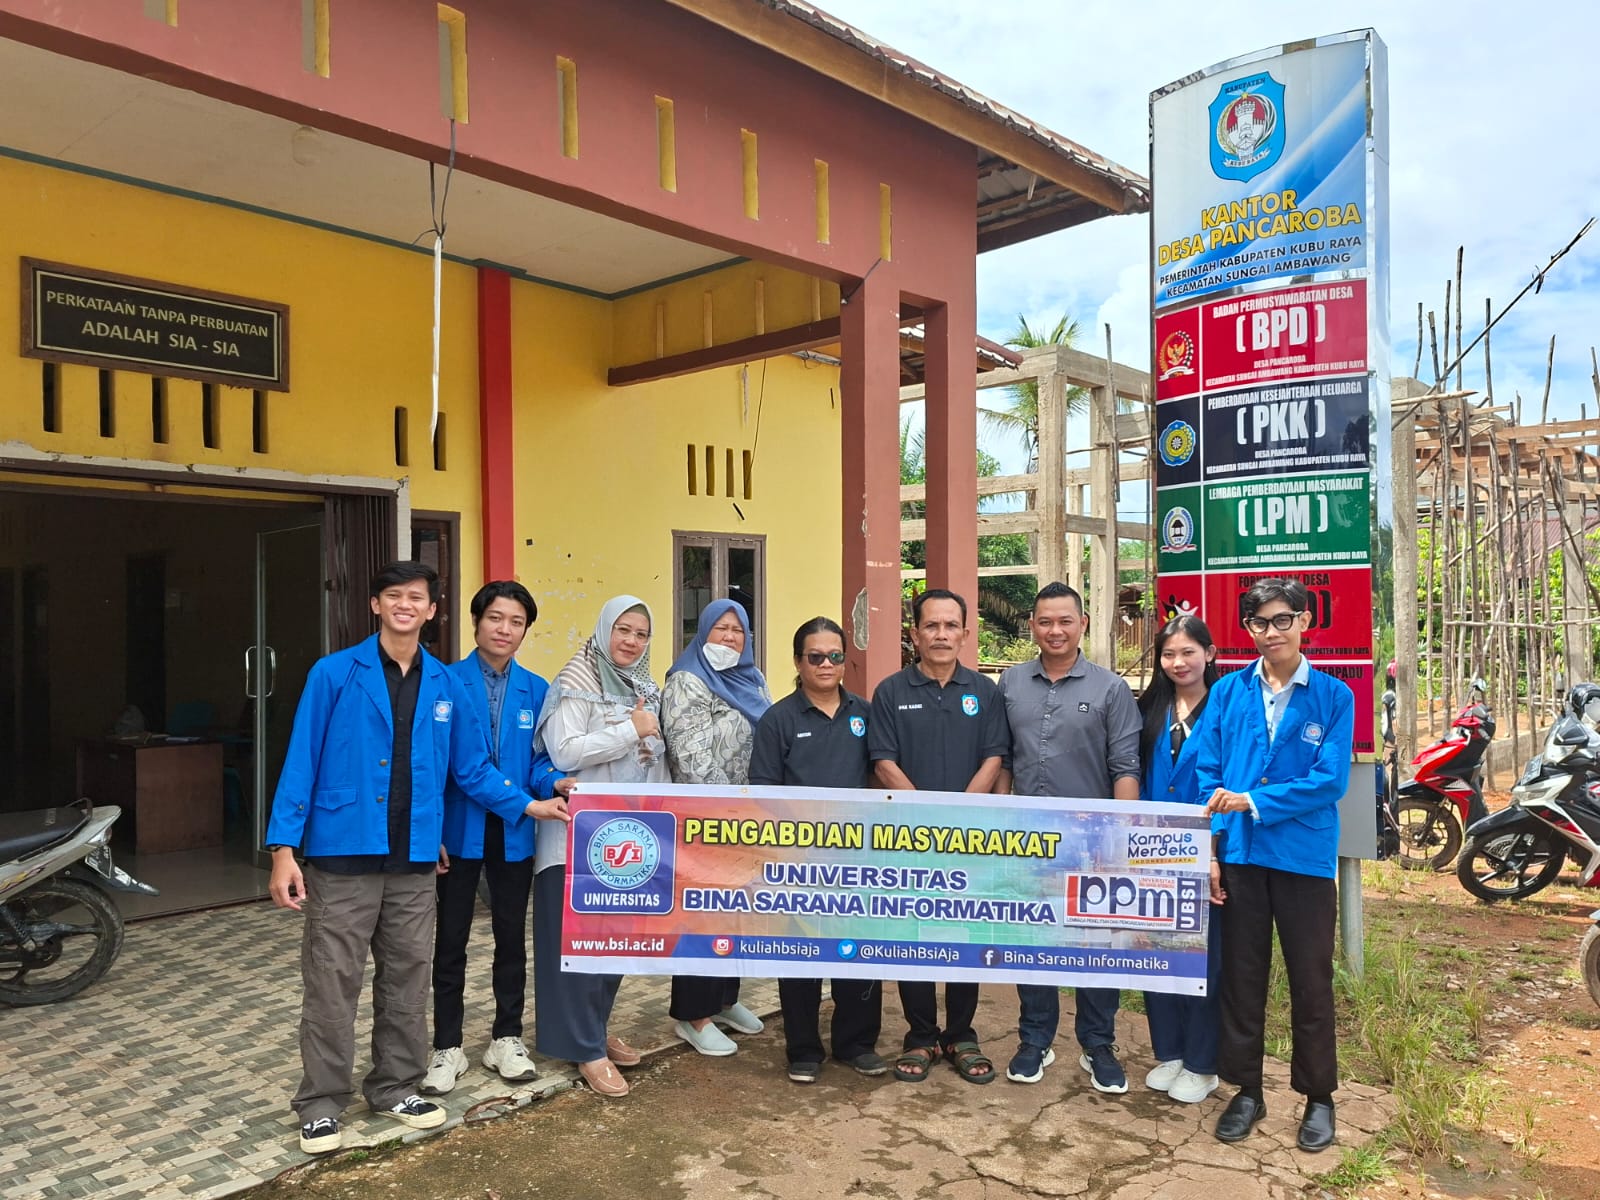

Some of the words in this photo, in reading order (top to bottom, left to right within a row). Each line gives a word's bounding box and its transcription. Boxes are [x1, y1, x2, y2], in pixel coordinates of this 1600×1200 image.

[1201, 189, 1298, 230] KANTOR
[1158, 234, 1205, 266] DESA
[1210, 203, 1362, 250] PANCAROBA
[1160, 261, 1217, 286] PEMERINTAH
[1219, 247, 1286, 269] KABUPATEN
[1290, 241, 1325, 255] KUBU
[1330, 236, 1362, 249] RAYA
[1167, 275, 1222, 297] KECAMATAN
[1226, 264, 1270, 281] SUNGAI
[1274, 252, 1351, 272] AMBAWANG
[46, 290, 136, 316] PERKATAAN
[140, 305, 186, 325] TANPA
[190, 315, 269, 338] PERBUATAN
[1213, 301, 1239, 319] BADAN
[1240, 289, 1328, 313] PERMUSYAWARATAN
[1329, 286, 1354, 299] DESA
[81, 320, 160, 345] ADALAH
[169, 333, 198, 351] SIA
[213, 340, 241, 357] SIA
[1208, 392, 1259, 411] PEMBERDAYAAN
[1261, 385, 1320, 402] KESEJAHTERAAN
[1321, 381, 1362, 396] KELUARGA
[1209, 487, 1242, 500] LEMBAGA
[1243, 481, 1305, 498] PEMBERDAYAAN
[1307, 477, 1363, 493] MASYARAKAT
[1304, 573, 1330, 586] DESA
[594, 827, 614, 848] BINA
[617, 822, 654, 850] SARANA
[684, 818, 864, 849] PENGABDIAN
[872, 822, 1061, 858] MASYARAKAT
[1128, 832, 1192, 848] Kampus
[605, 842, 641, 866] BSI
[1128, 844, 1198, 858] Merdeka
[594, 862, 653, 885] INFORMATIKA
[763, 862, 967, 891] UNIVERSITAS
[584, 893, 660, 906] UNIVERSITAS
[683, 888, 749, 912] BINA
[753, 891, 865, 916] SARANA
[870, 894, 1056, 924] INFORMATIKA
[1180, 880, 1196, 929] UBSI
[571, 938, 664, 952] www.bsi.ac.id
[740, 940, 820, 957] kuliahbsiaja
[860, 944, 960, 962] @KuliahBsiAja
[1004, 951, 1033, 965] Bina
[1038, 953, 1084, 967] Sarana
[1088, 954, 1169, 970] Informatika
